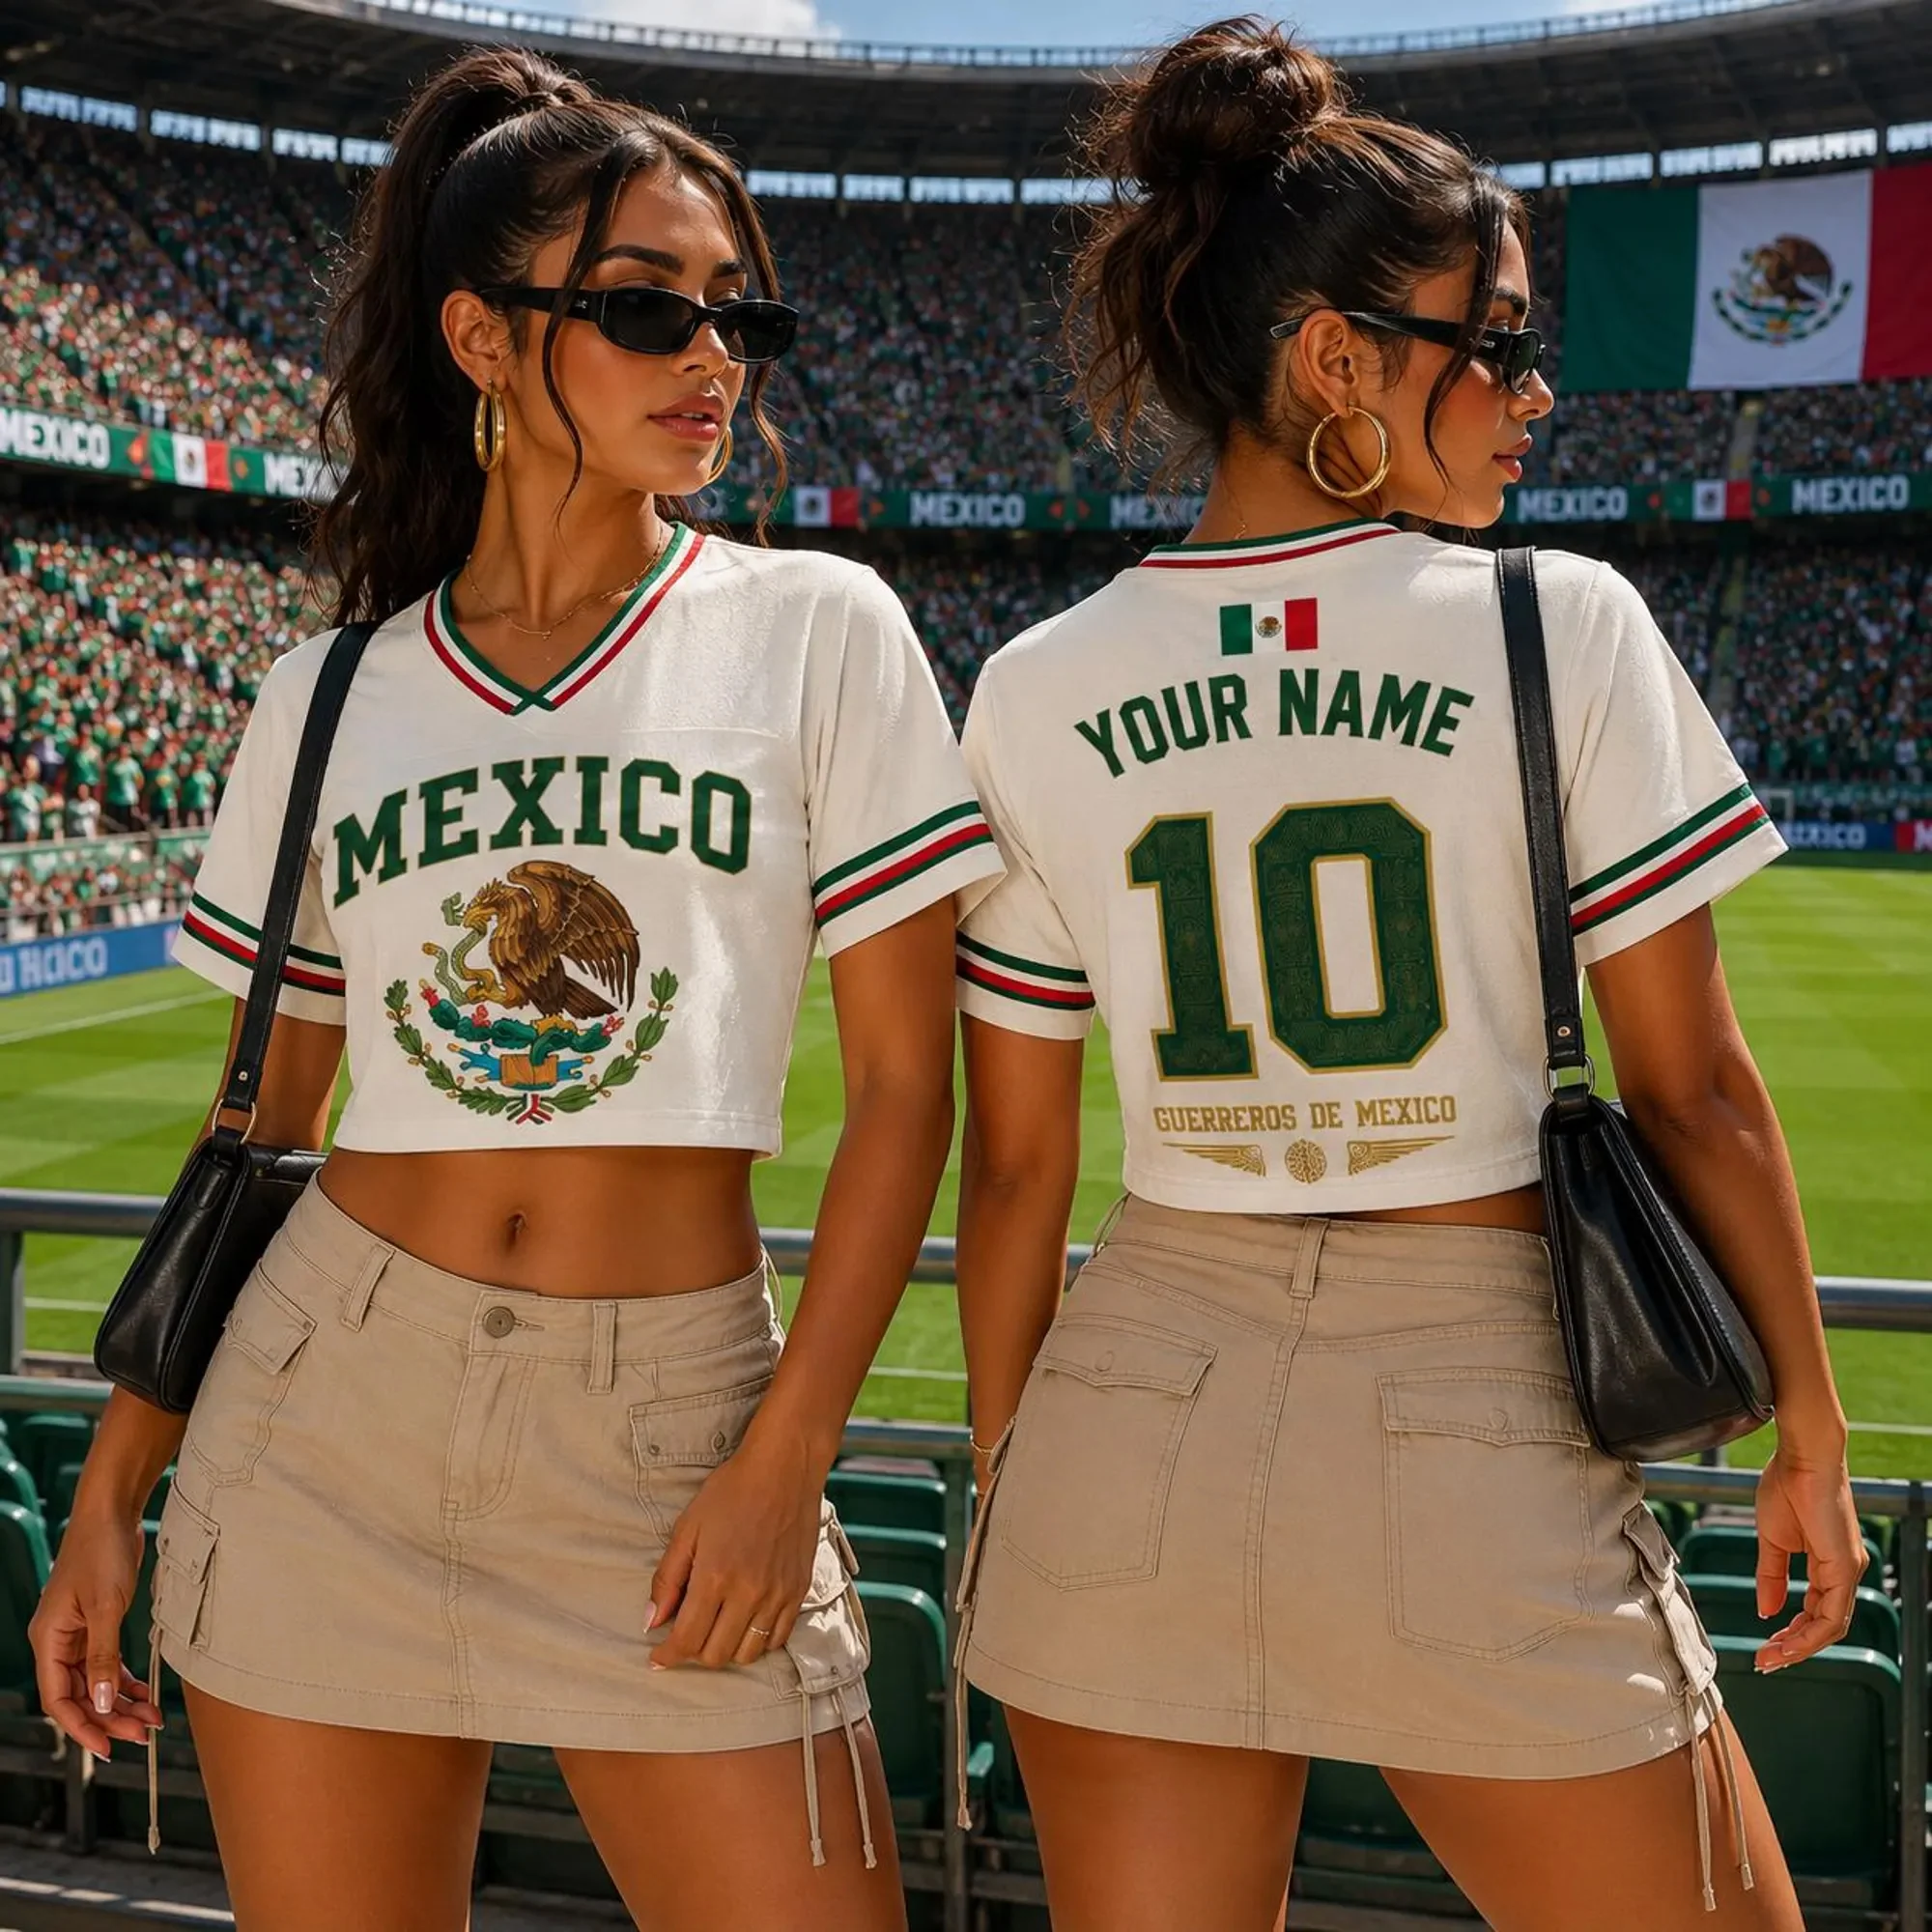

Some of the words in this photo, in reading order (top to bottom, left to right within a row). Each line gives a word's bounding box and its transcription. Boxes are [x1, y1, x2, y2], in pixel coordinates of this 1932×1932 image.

[0, 407, 110, 469] MEXICO
[909, 490, 1026, 527] MEXICO
[1110, 493, 1208, 529] MEXIC
[1518, 487, 1628, 522] MEXICO
[1792, 473, 1910, 512] MEXICO
[1074, 673, 1253, 779] YOUR
[1278, 668, 1475, 757] NAME
[333, 755, 752, 909] MEXICO
[1124, 796, 1448, 1082] 10
[1152, 1103, 1297, 1133] GUERREROS
[1309, 1101, 1344, 1130] DE
[1354, 1095, 1458, 1127] MEXICO
